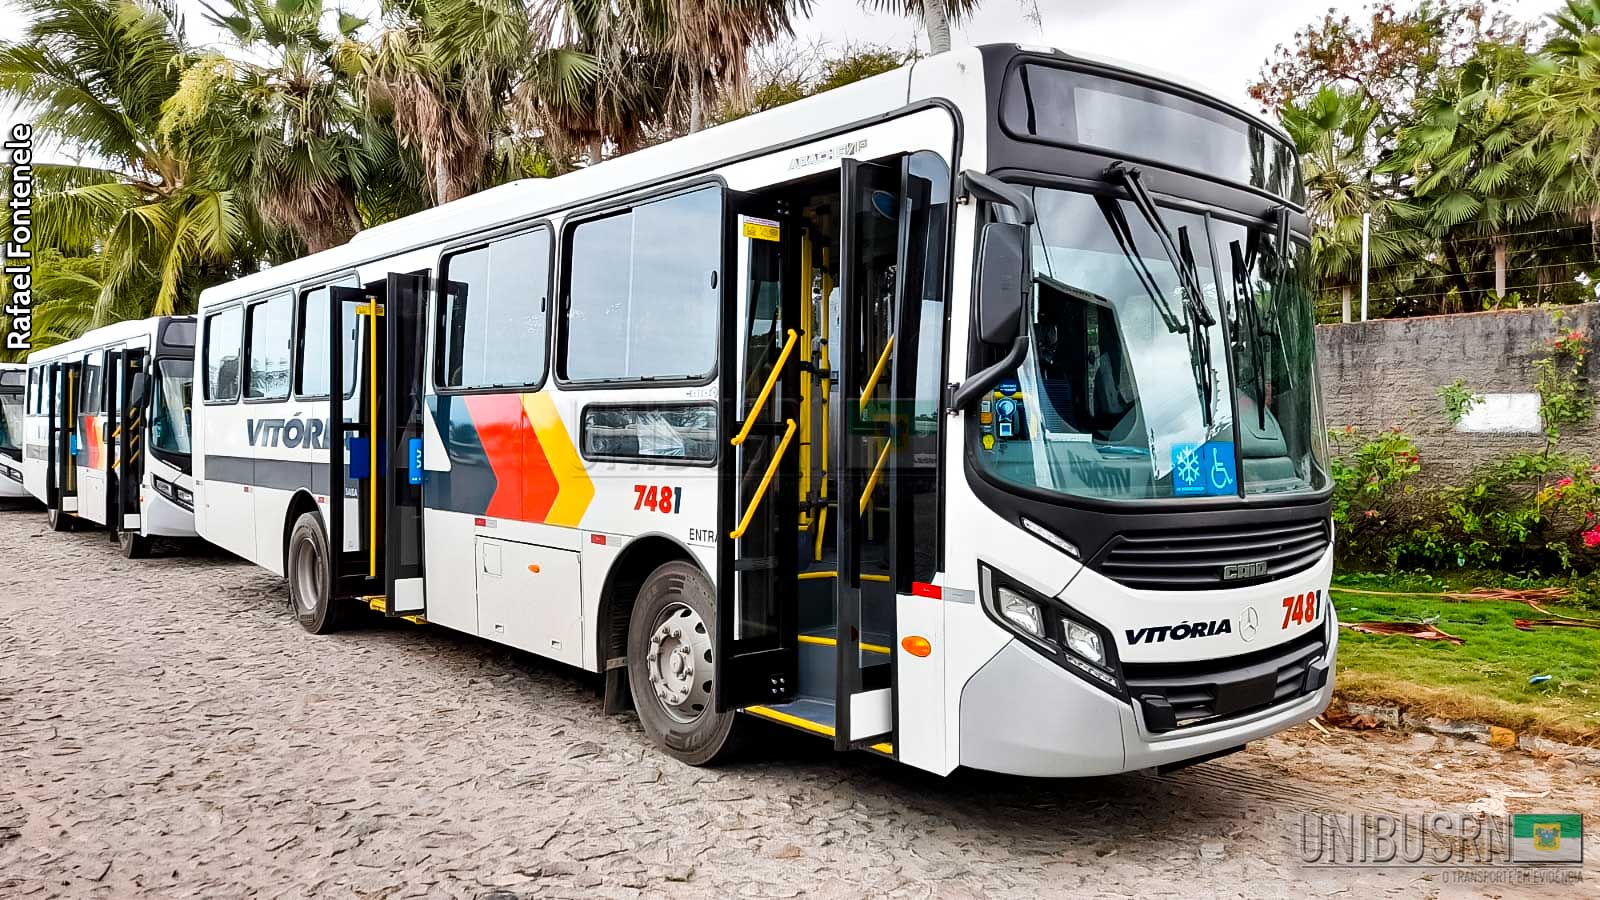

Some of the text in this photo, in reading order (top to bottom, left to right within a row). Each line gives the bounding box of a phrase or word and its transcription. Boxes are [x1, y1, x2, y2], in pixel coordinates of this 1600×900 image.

[633, 484, 682, 514] 7481
[1281, 589, 1322, 630] 7481
[1125, 618, 1232, 646] VITÓRIA
